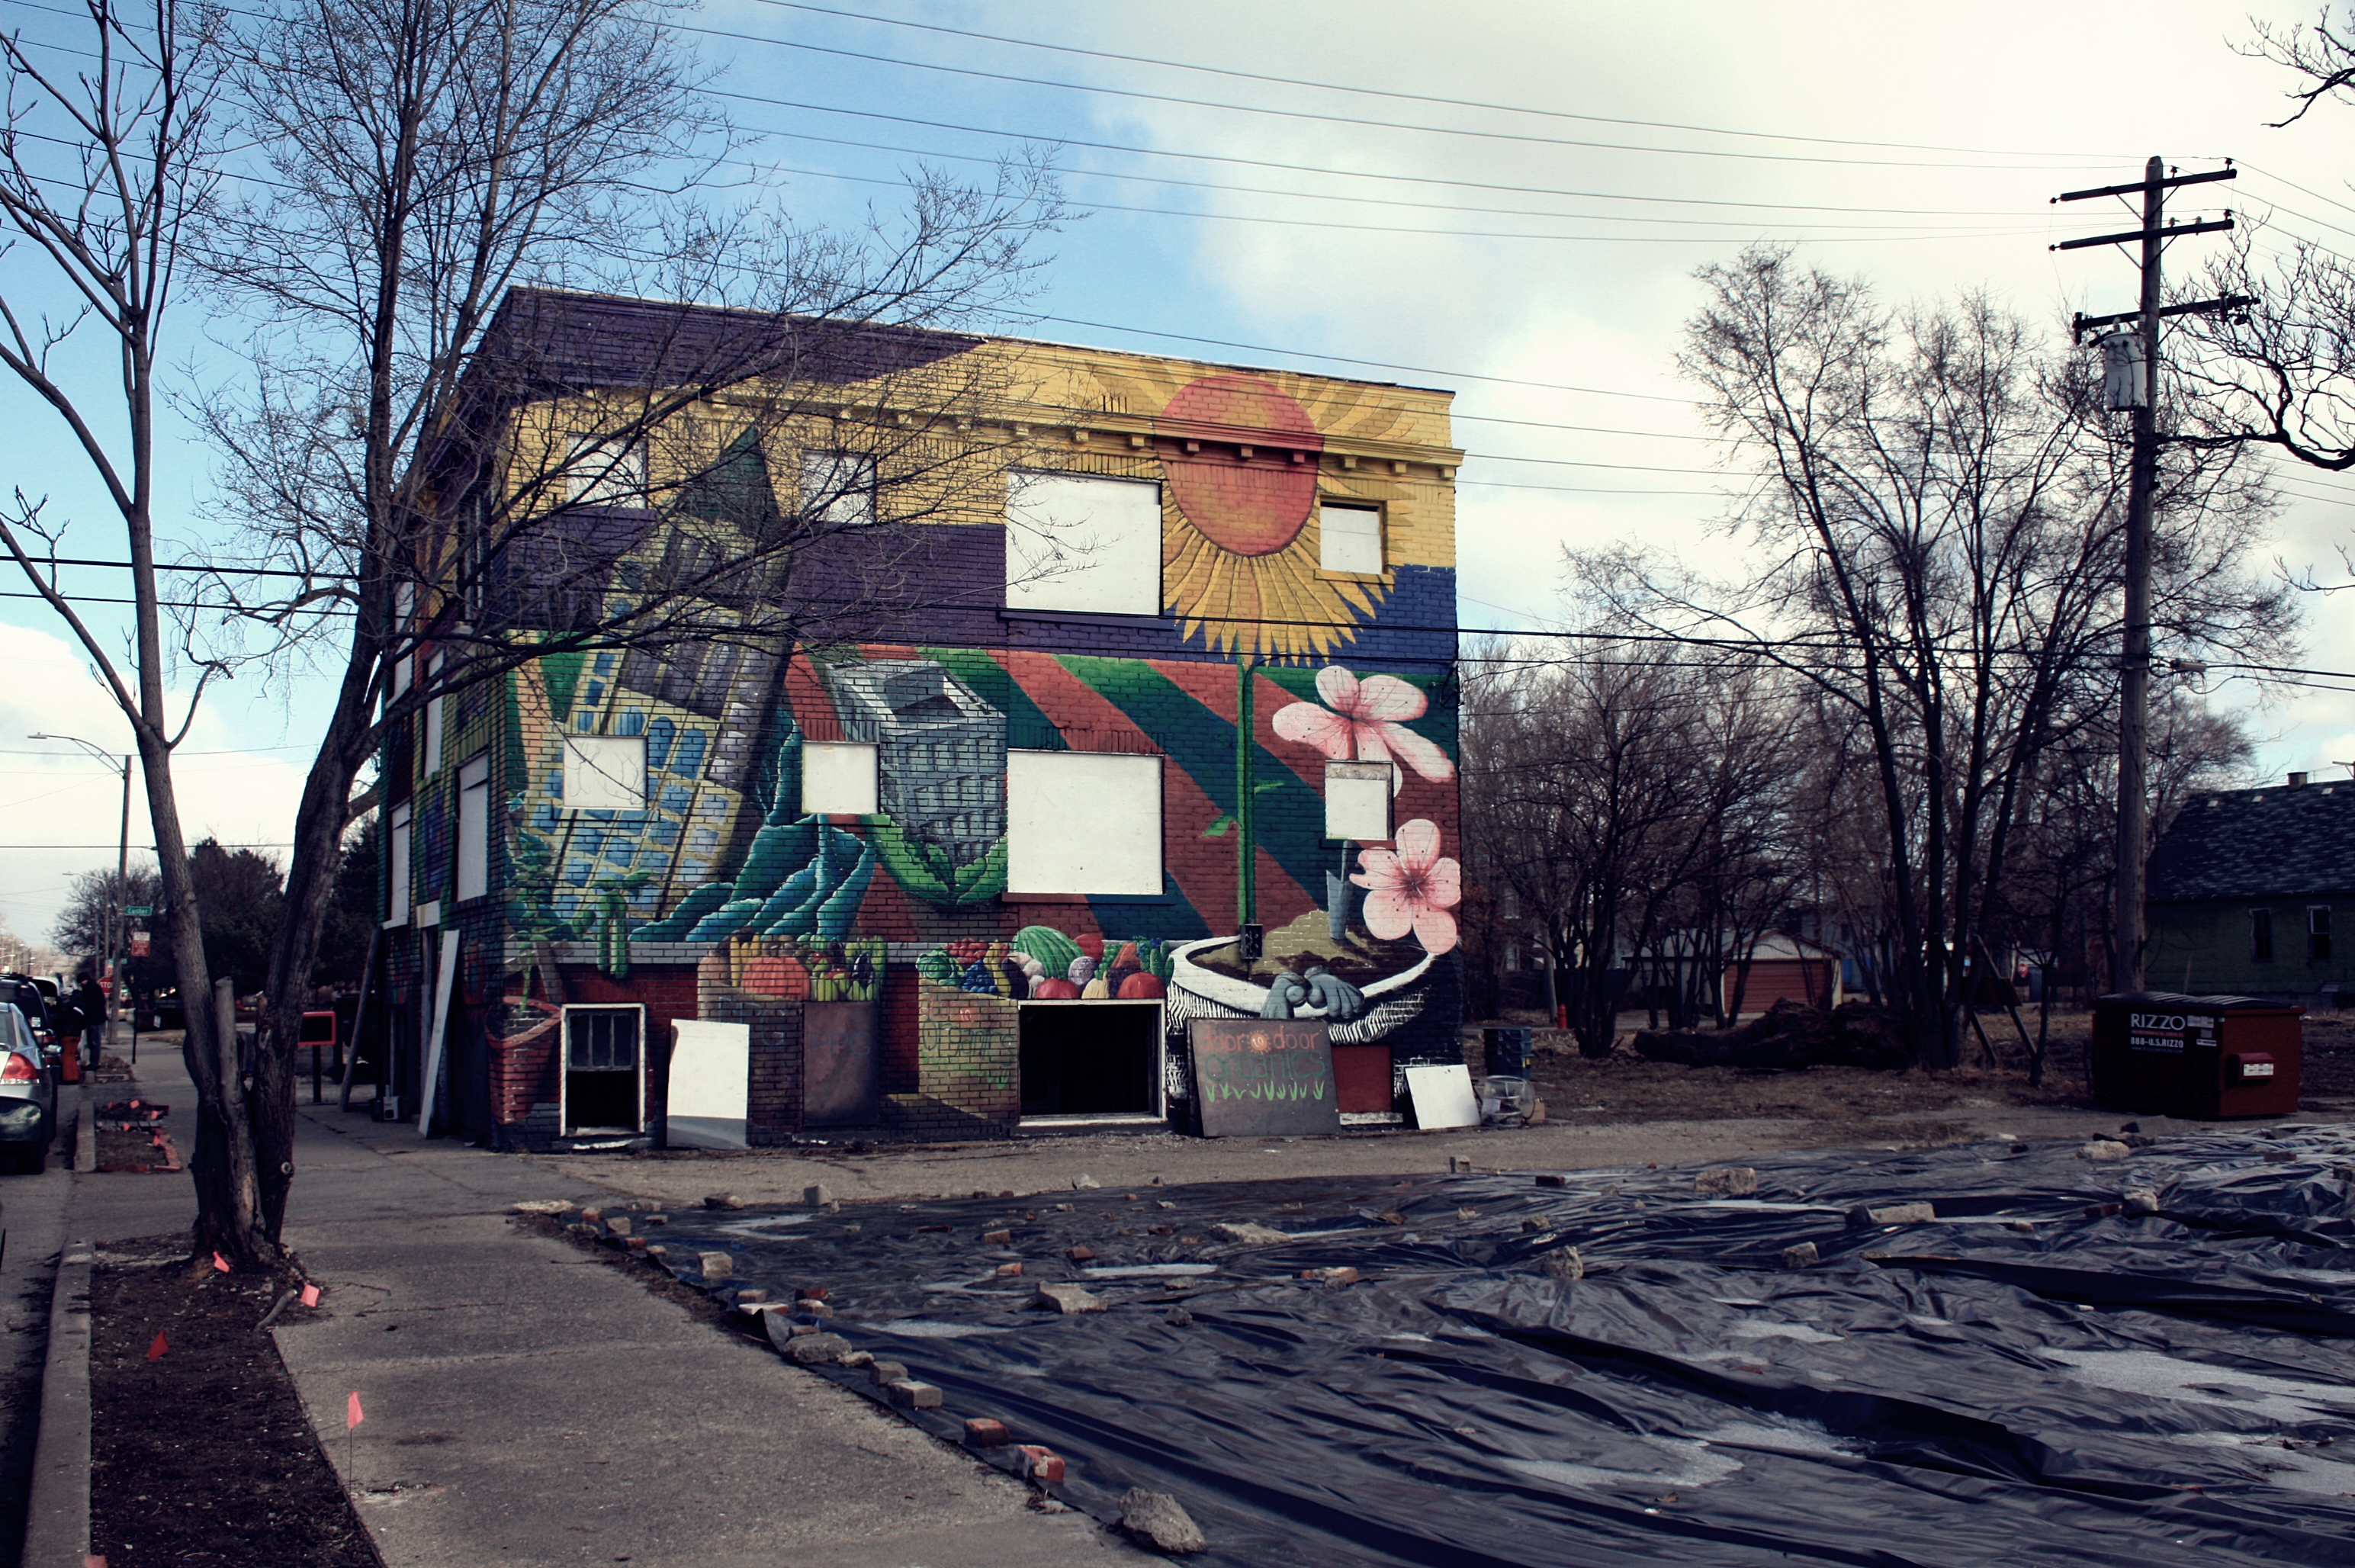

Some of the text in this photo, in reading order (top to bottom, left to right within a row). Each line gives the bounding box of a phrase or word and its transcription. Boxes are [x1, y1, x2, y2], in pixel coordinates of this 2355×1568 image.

[2131, 1014, 2186, 1030] RIZZO
[810, 1032, 872, 1058] PPG
[1200, 1024, 1320, 1052] door to door
